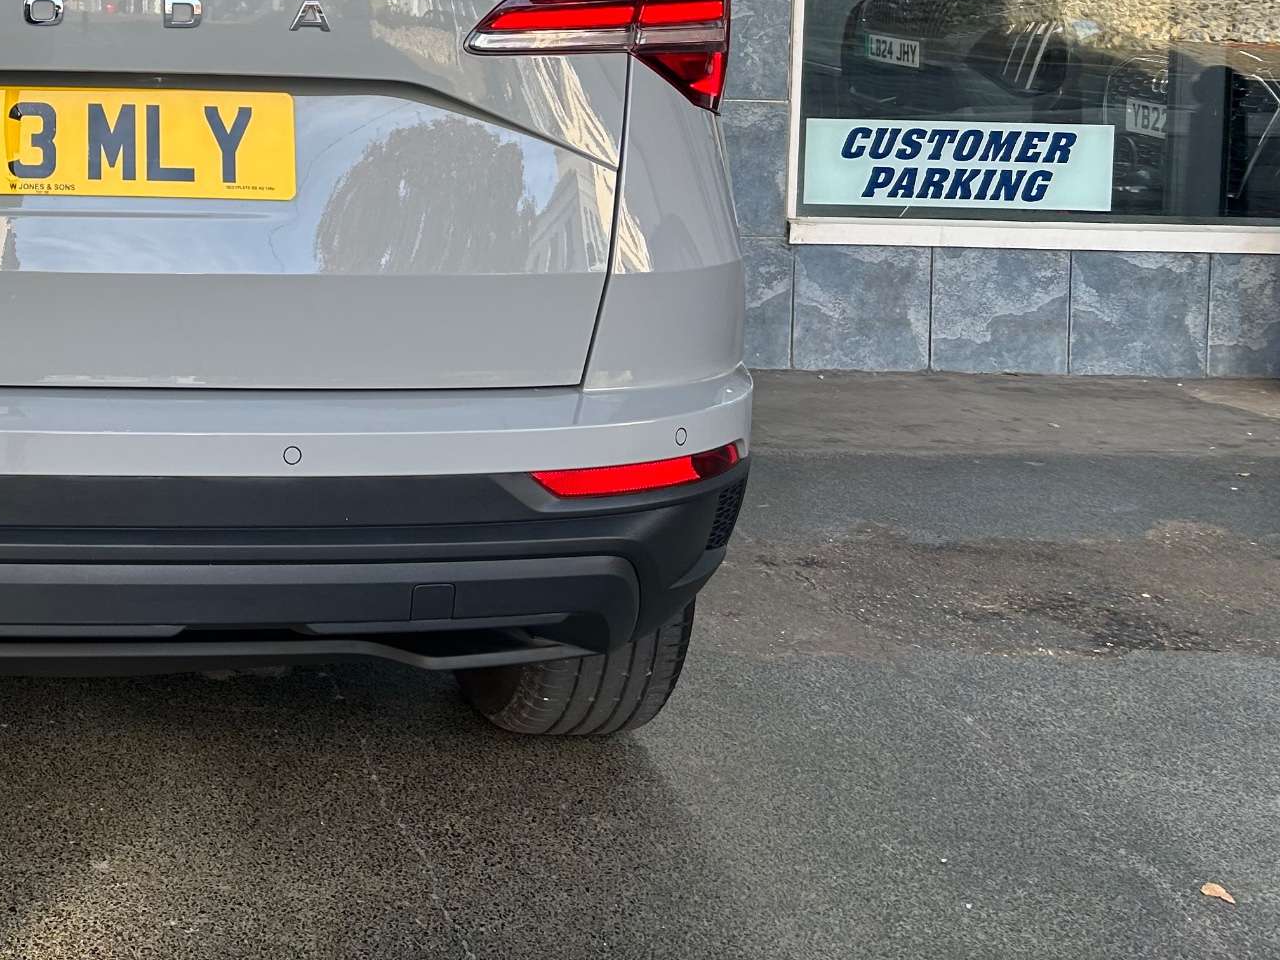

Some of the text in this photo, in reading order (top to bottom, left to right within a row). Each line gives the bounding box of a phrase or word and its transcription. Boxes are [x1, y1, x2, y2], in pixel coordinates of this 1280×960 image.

[870, 37, 917, 64] LB24 JHY
[88, 102, 253, 184] MLY
[840, 126, 1078, 164] CUSTOMER
[9, 183, 17, 191] W
[18, 183, 45, 191] JONES
[46, 183, 52, 191] &
[54, 183, 76, 192] SONS
[861, 166, 1054, 203] PARKING
